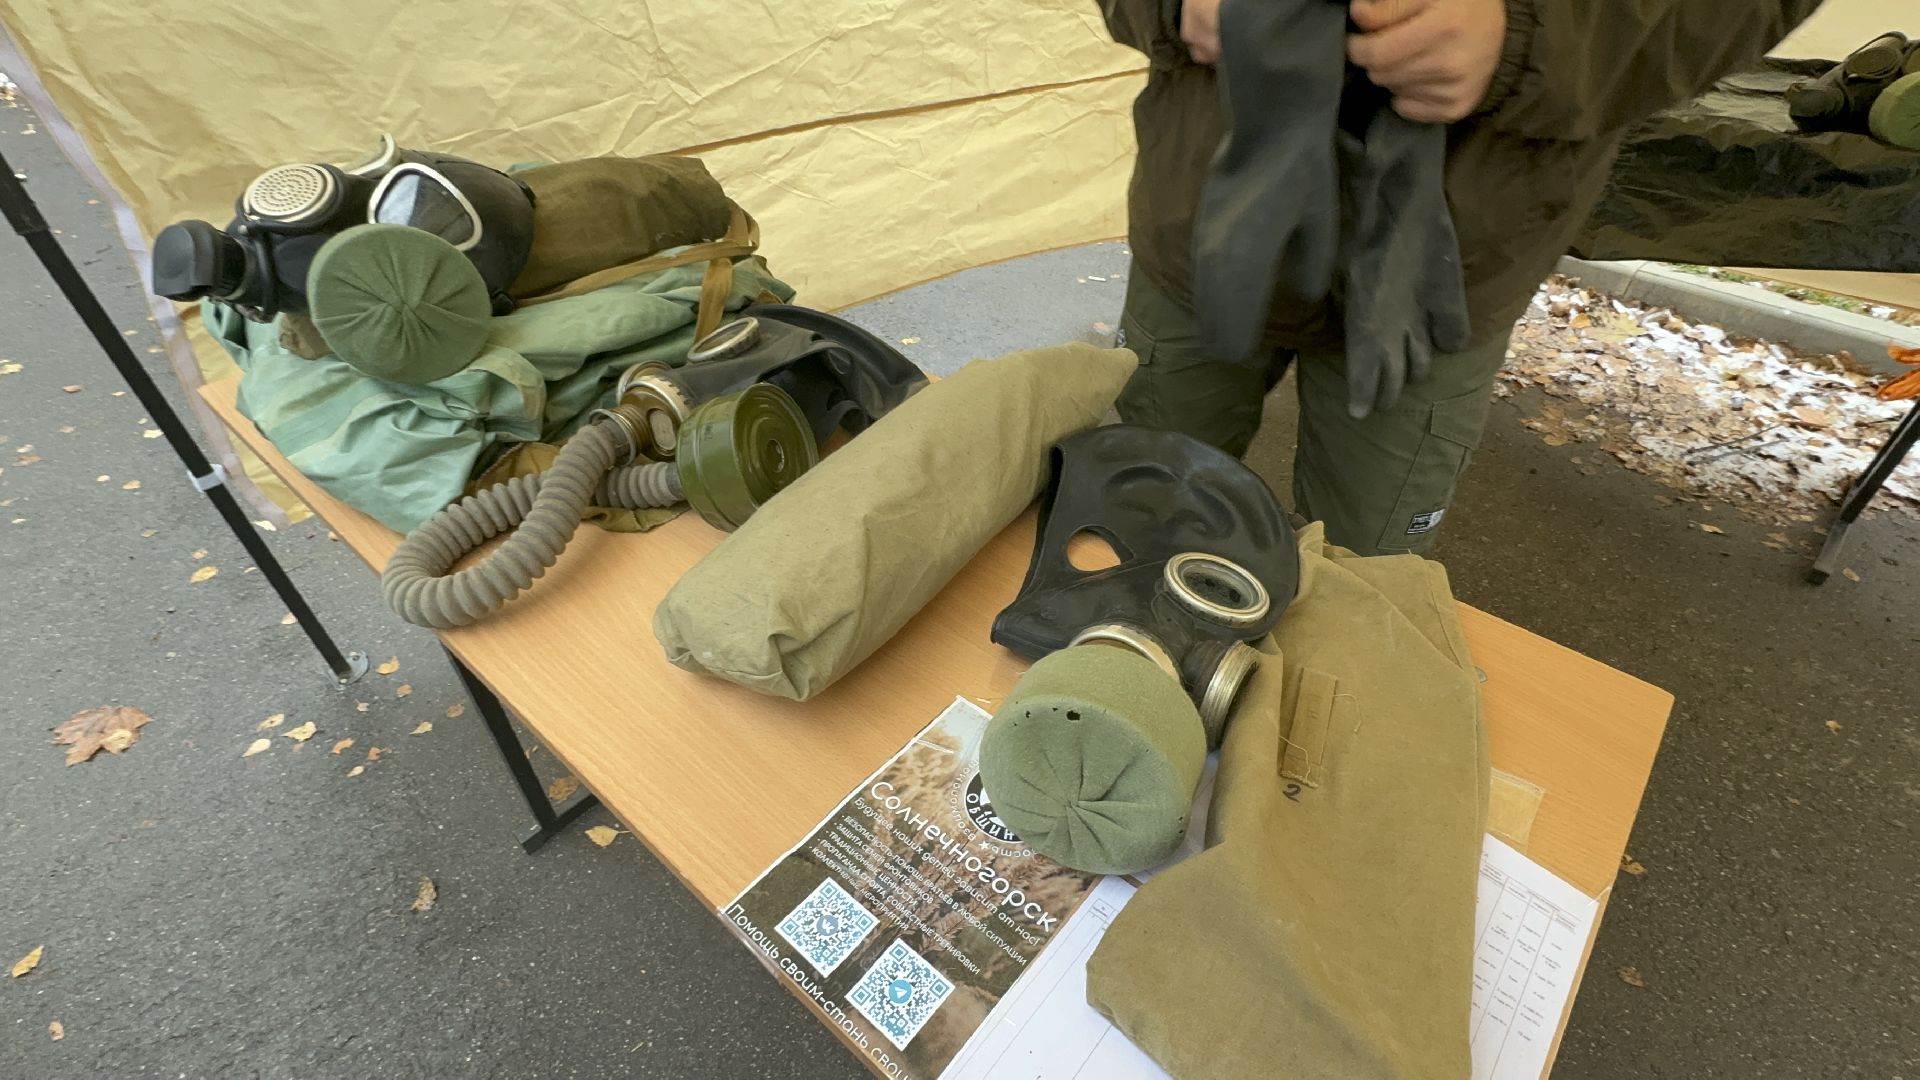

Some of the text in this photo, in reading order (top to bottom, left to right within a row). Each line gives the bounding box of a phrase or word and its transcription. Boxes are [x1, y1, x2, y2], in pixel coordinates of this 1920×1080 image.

[828, 830, 880, 876] ТРАДИЦИОННЫЕ
[872, 780, 1057, 932] Солнечногорск
[966, 793, 1017, 841] ОБЩИН
[819, 839, 860, 876] ПРОПАГАНДА
[886, 894, 934, 936] СОВМЕСТНЫЕ
[932, 933, 980, 975] ТРЕНИРОВКИ
[835, 823, 934, 905] ЗАЩИТА СЕМЕЙ ФРОНТОВИКОВ
[853, 796, 1040, 946] Будущее наших детей зависит от нас!
[859, 888, 909, 931] МЕРОПРИЯТИЯ
[922, 878, 953, 905] БРАТЬЕВ
[951, 901, 959, 910] В
[956, 907, 988, 932] ЛЮБОЙ
[985, 929, 1027, 966] СИТУАЦИИ
[726, 903, 780, 959] Помощь
[779, 956, 868, 1048] своим-стань
